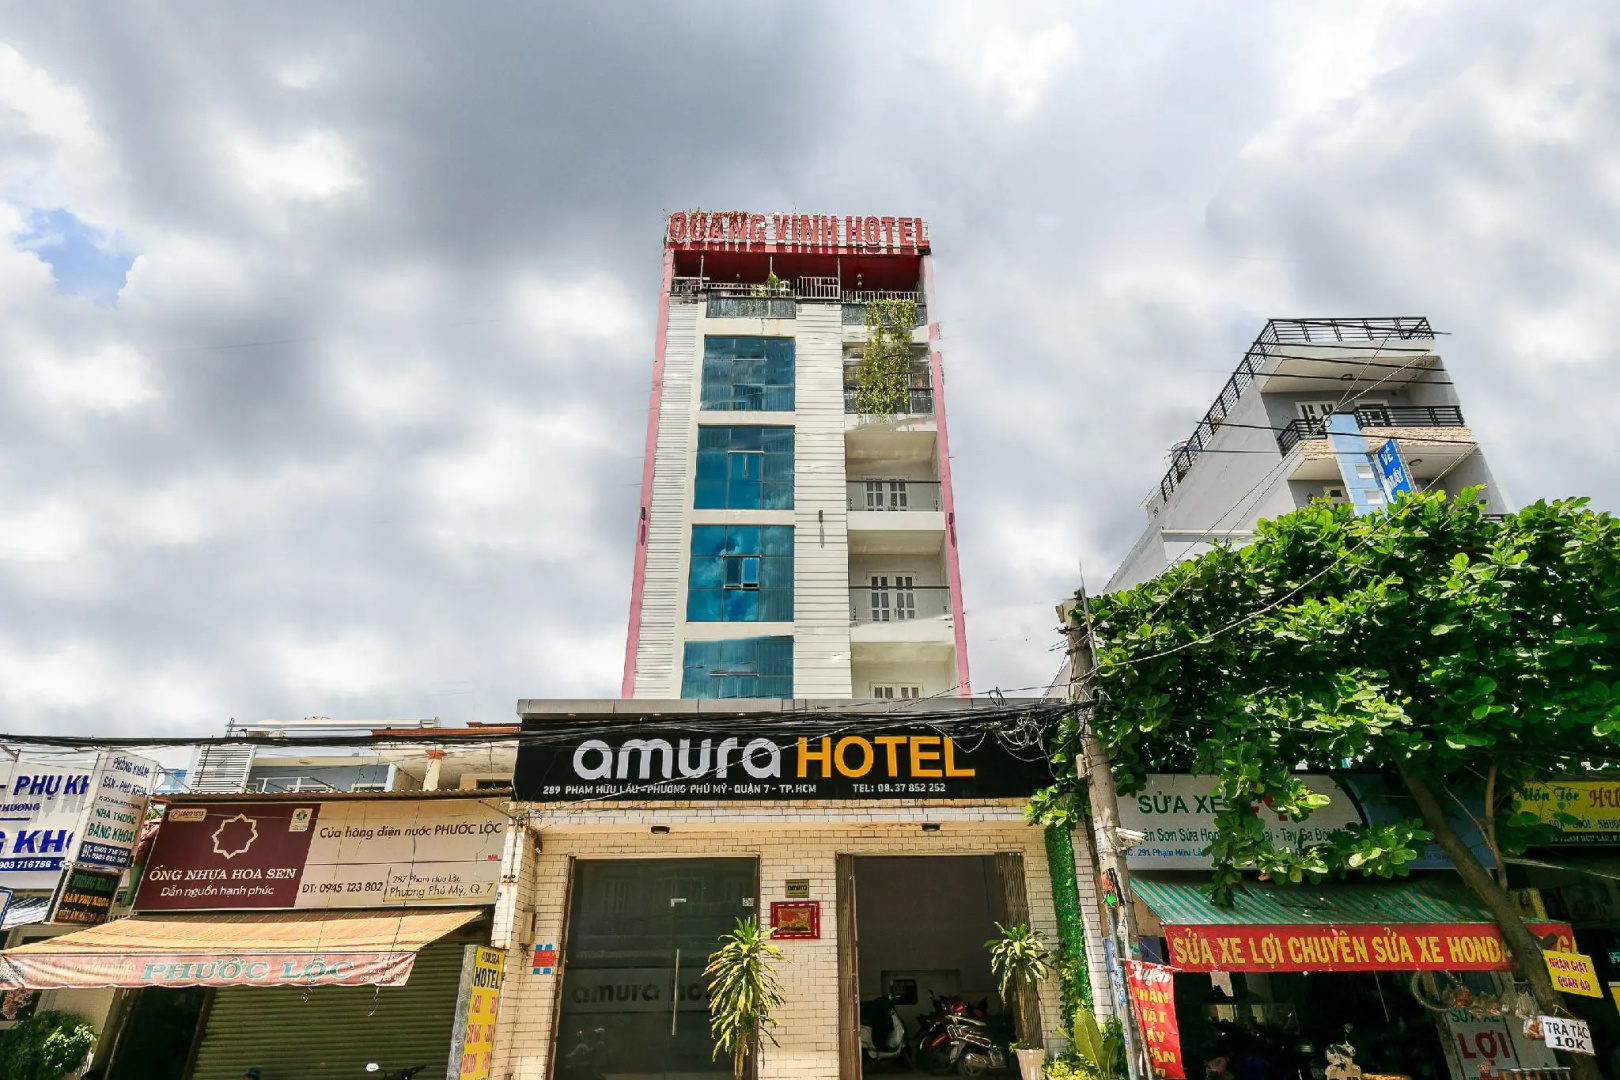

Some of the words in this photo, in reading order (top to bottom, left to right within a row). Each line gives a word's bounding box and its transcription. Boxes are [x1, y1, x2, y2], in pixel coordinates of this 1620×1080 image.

[773, 214, 838, 246] VINH
[846, 216, 930, 247] HOTEL
[572, 737, 780, 780] amura
[797, 736, 975, 778] HOTEL
[12, 775, 63, 800] PHỤ
[542, 785, 561, 795] 289
[734, 783, 761, 795] QUẬN
[763, 784, 770, 793] 7
[852, 784, 874, 793] TEL:
[908, 783, 926, 792] 852
[928, 783, 946, 792] 252
[1138, 791, 1190, 814] SỬA
[345, 825, 374, 840] hàng
[434, 820, 476, 836] PHƯỚC
[1157, 828, 1178, 842] Sơn
[1280, 828, 1297, 844] Tay
[1138, 848, 1150, 856] 291
[149, 865, 182, 882] ỐNG
[184, 868, 227, 883] NHỰA
[231, 869, 262, 880] HOA
[266, 868, 297, 879] SEN
[161, 885, 183, 897] Dẫn
[184, 885, 218, 897] nguồn
[220, 886, 246, 898] hạnh
[248, 885, 274, 897] phúc
[302, 883, 316, 893] ĐT:
[319, 882, 342, 893] 0945
[347, 882, 363, 892] 123
[364, 881, 383, 892] 802
[428, 884, 445, 896] Phú
[470, 884, 483, 894] Q.
[486, 883, 494, 893] 7
[1172, 927, 1213, 964] SỬA
[1216, 937, 1246, 964] XE
[1249, 933, 1284, 969] LỢI
[1288, 930, 1370, 964] CHUYÊN
[1374, 926, 1414, 964] SỬA
[1416, 937, 1445, 964] XE
[141, 957, 270, 981] PHƯỚC
[279, 958, 355, 984] LỘC
[473, 966, 500, 989] HOTEL
[1545, 1019, 1569, 1037] TRÀ
[1457, 1029, 1511, 1066] LỢI
[1555, 1036, 1587, 1051] 10K
